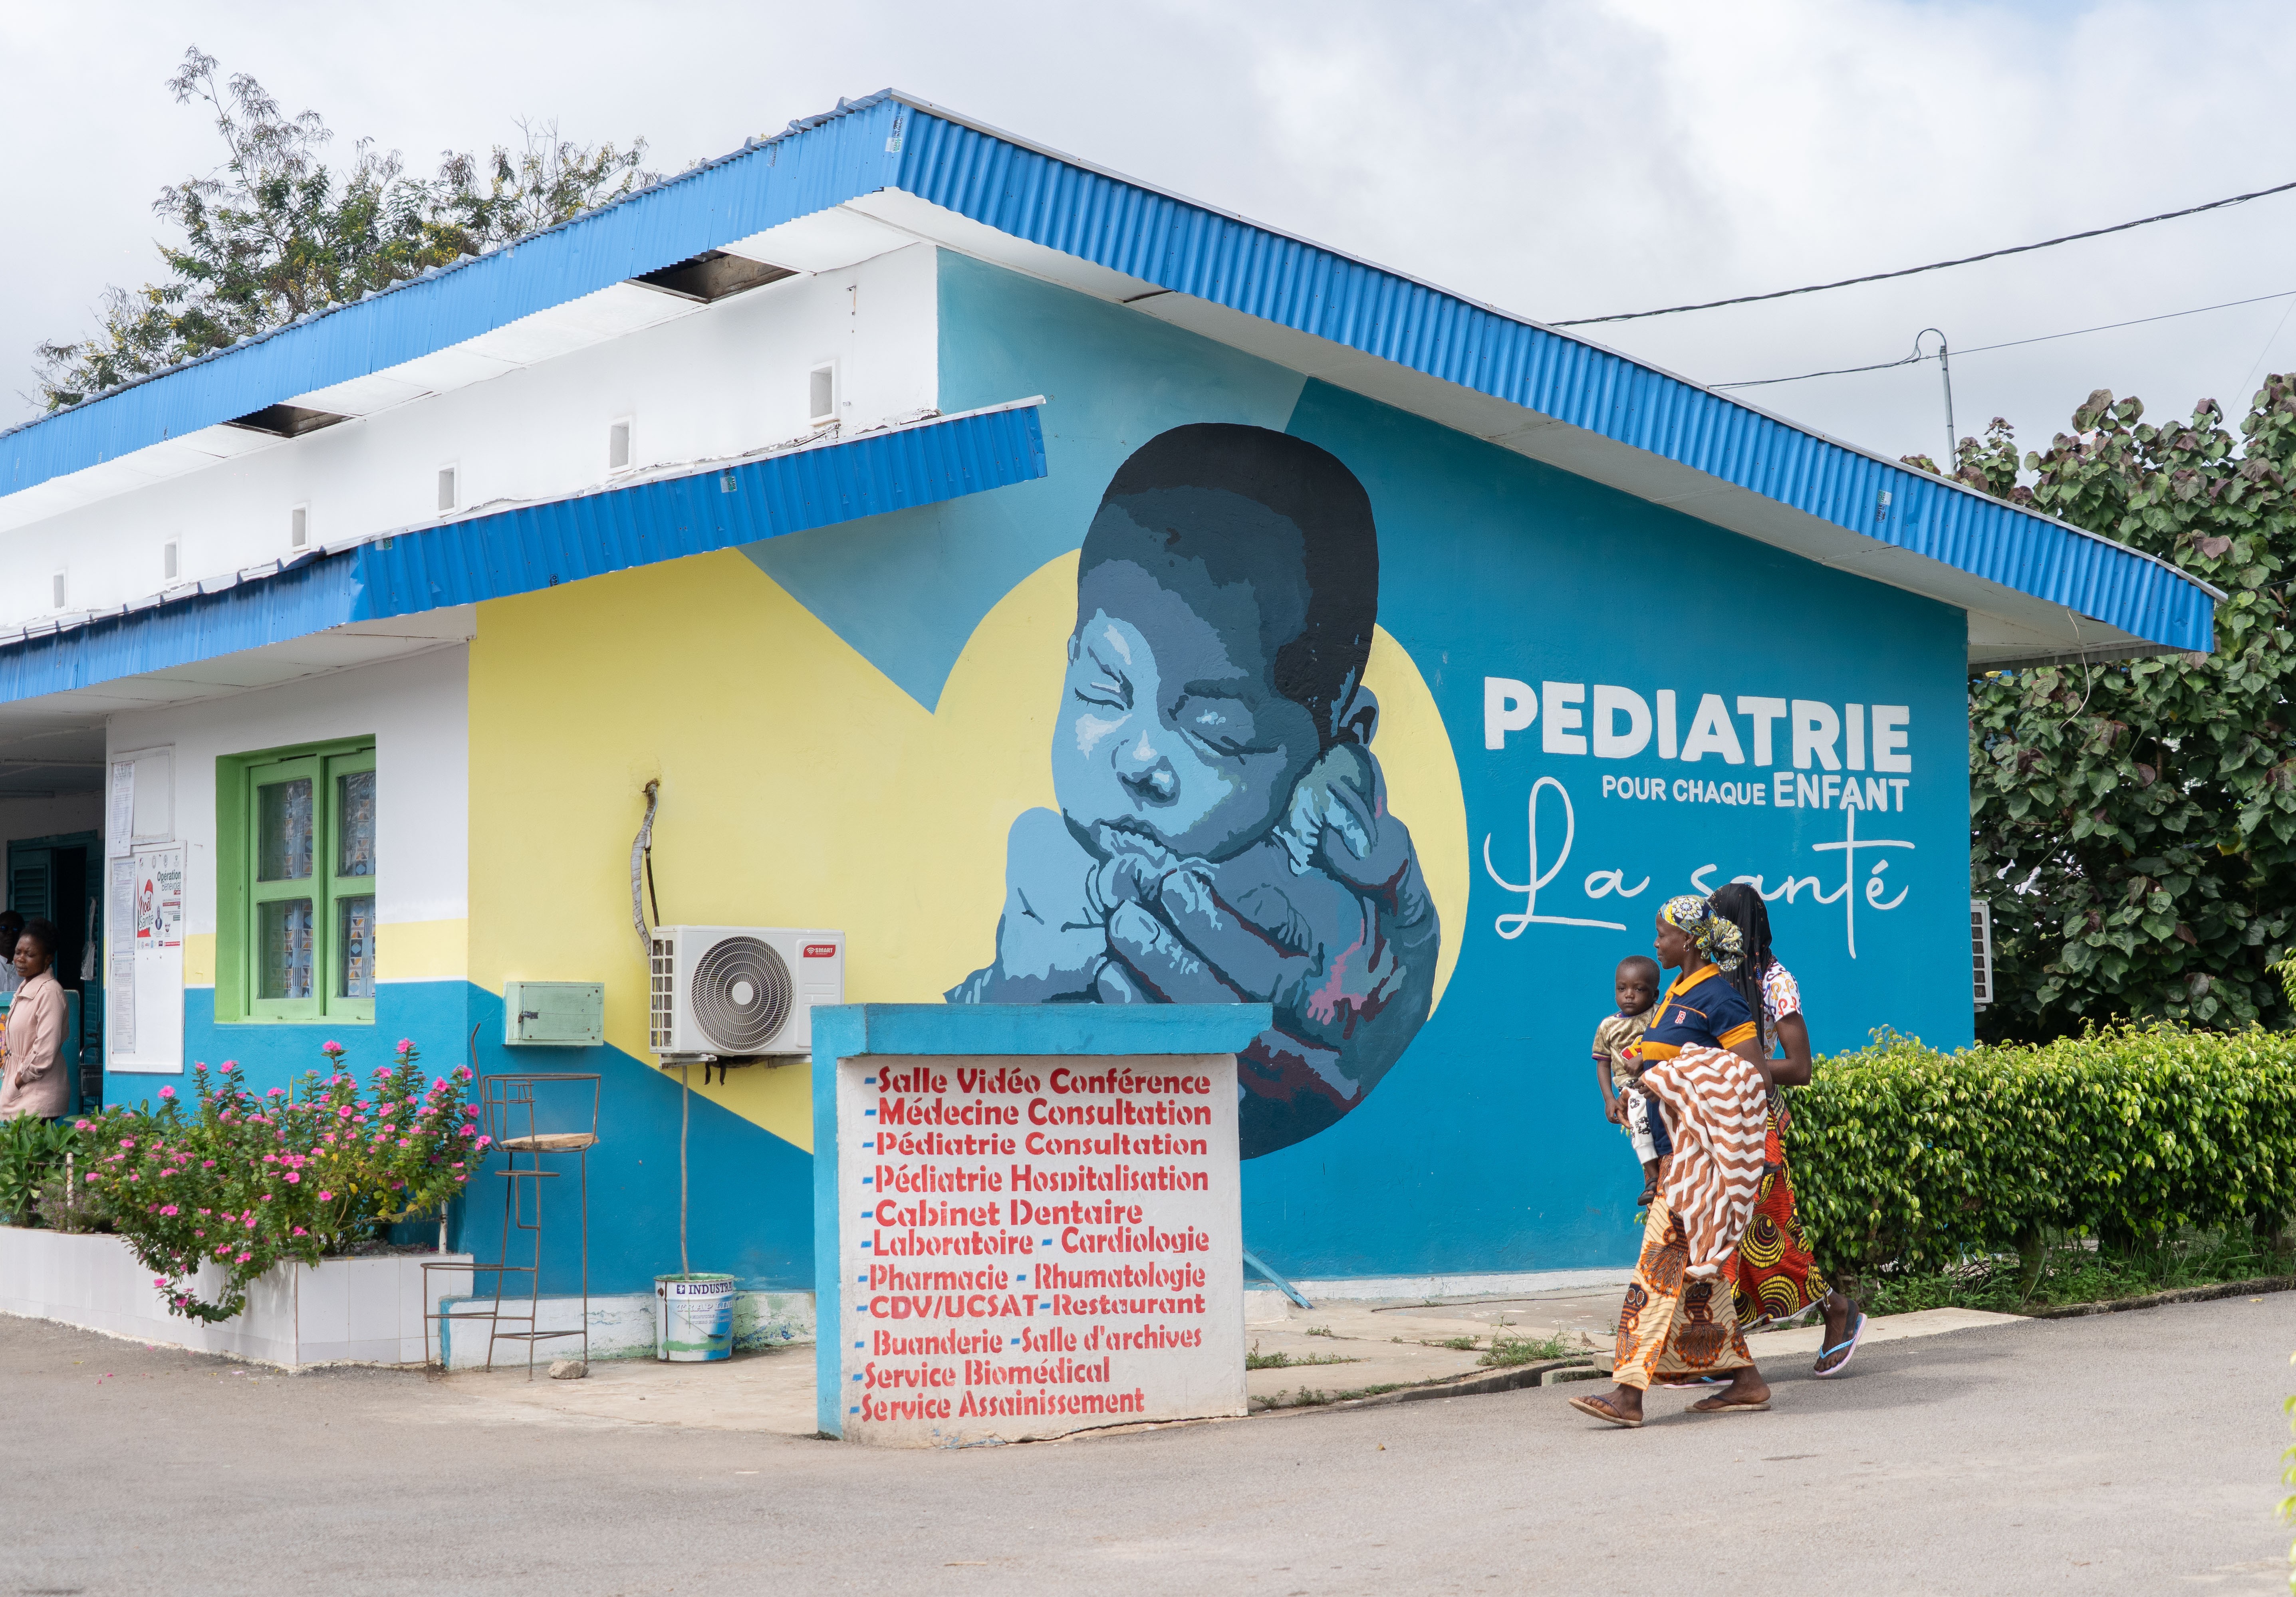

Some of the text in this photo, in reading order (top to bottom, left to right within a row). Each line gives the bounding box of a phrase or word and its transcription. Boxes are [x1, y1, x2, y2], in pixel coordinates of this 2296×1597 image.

[1484, 676, 1911, 773] PEDIATRIE
[1603, 771, 1909, 811] POUR CHAQUE ENFANT
[1483, 777, 1650, 939] La
[157, 869, 181, 883] Opération
[162, 880, 181, 891] Bénévolat
[139, 894, 151, 915] Noël
[139, 911, 154, 928] Santé
[1675, 1011, 1686, 1024] R
[957, 1068, 1040, 1094] Vidéo
[1050, 1068, 1210, 1094] Conférence
[1028, 1098, 1211, 1125] Consultation
[1025, 1132, 1207, 1155] Consultation
[1011, 1164, 1208, 1191] Hospitalisation
[1011, 1199, 1142, 1225] Dentaire
[1062, 1226, 1209, 1253] Cardiologie
[1035, 1262, 1205, 1292] Rhumatologie
[677, 1303, 713, 1312] TRAP
[874, 1328, 1002, 1356] Buanderie
[1084, 1324, 1201, 1350] d'archives
[965, 1356, 1109, 1385] Biomédical
[958, 1388, 1144, 1417] Assainissement
